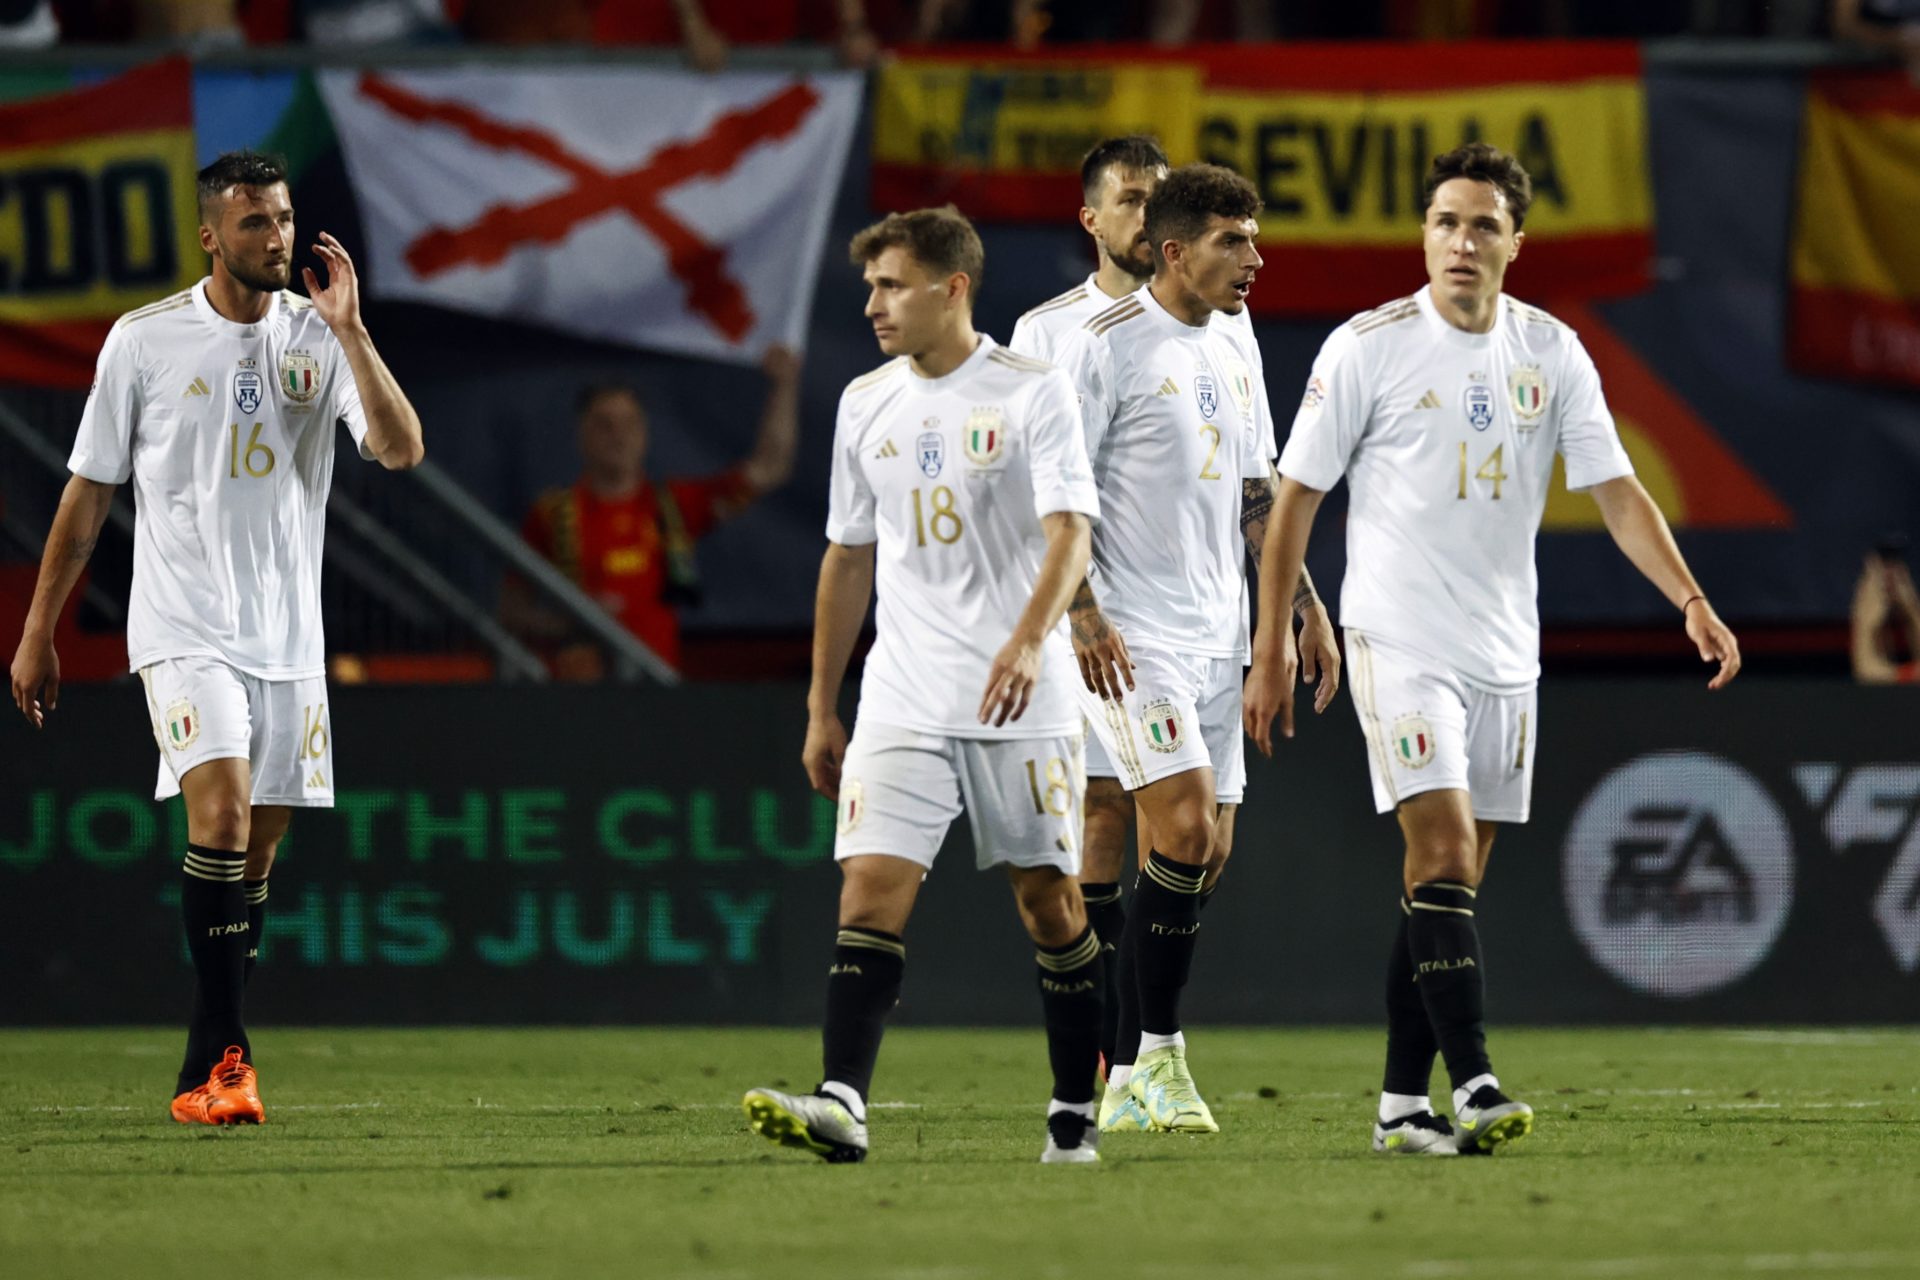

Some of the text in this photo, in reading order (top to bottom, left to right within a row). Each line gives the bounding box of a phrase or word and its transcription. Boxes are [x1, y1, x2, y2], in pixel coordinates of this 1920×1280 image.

[1203, 110, 1570, 219] SEVILA
[0, 159, 178, 294] DO
[230, 422, 275, 479] 16
[1198, 423, 1222, 480] 2
[1457, 440, 1508, 500] 14
[911, 485, 963, 547] 18
[300, 703, 328, 760] 16
[1025, 757, 1072, 817] 18
[331, 786, 568, 863] THE
[158, 882, 777, 968] HIS JULY
[209, 921, 250, 937] ITALIA
[1419, 956, 1475, 974] ITALIA
